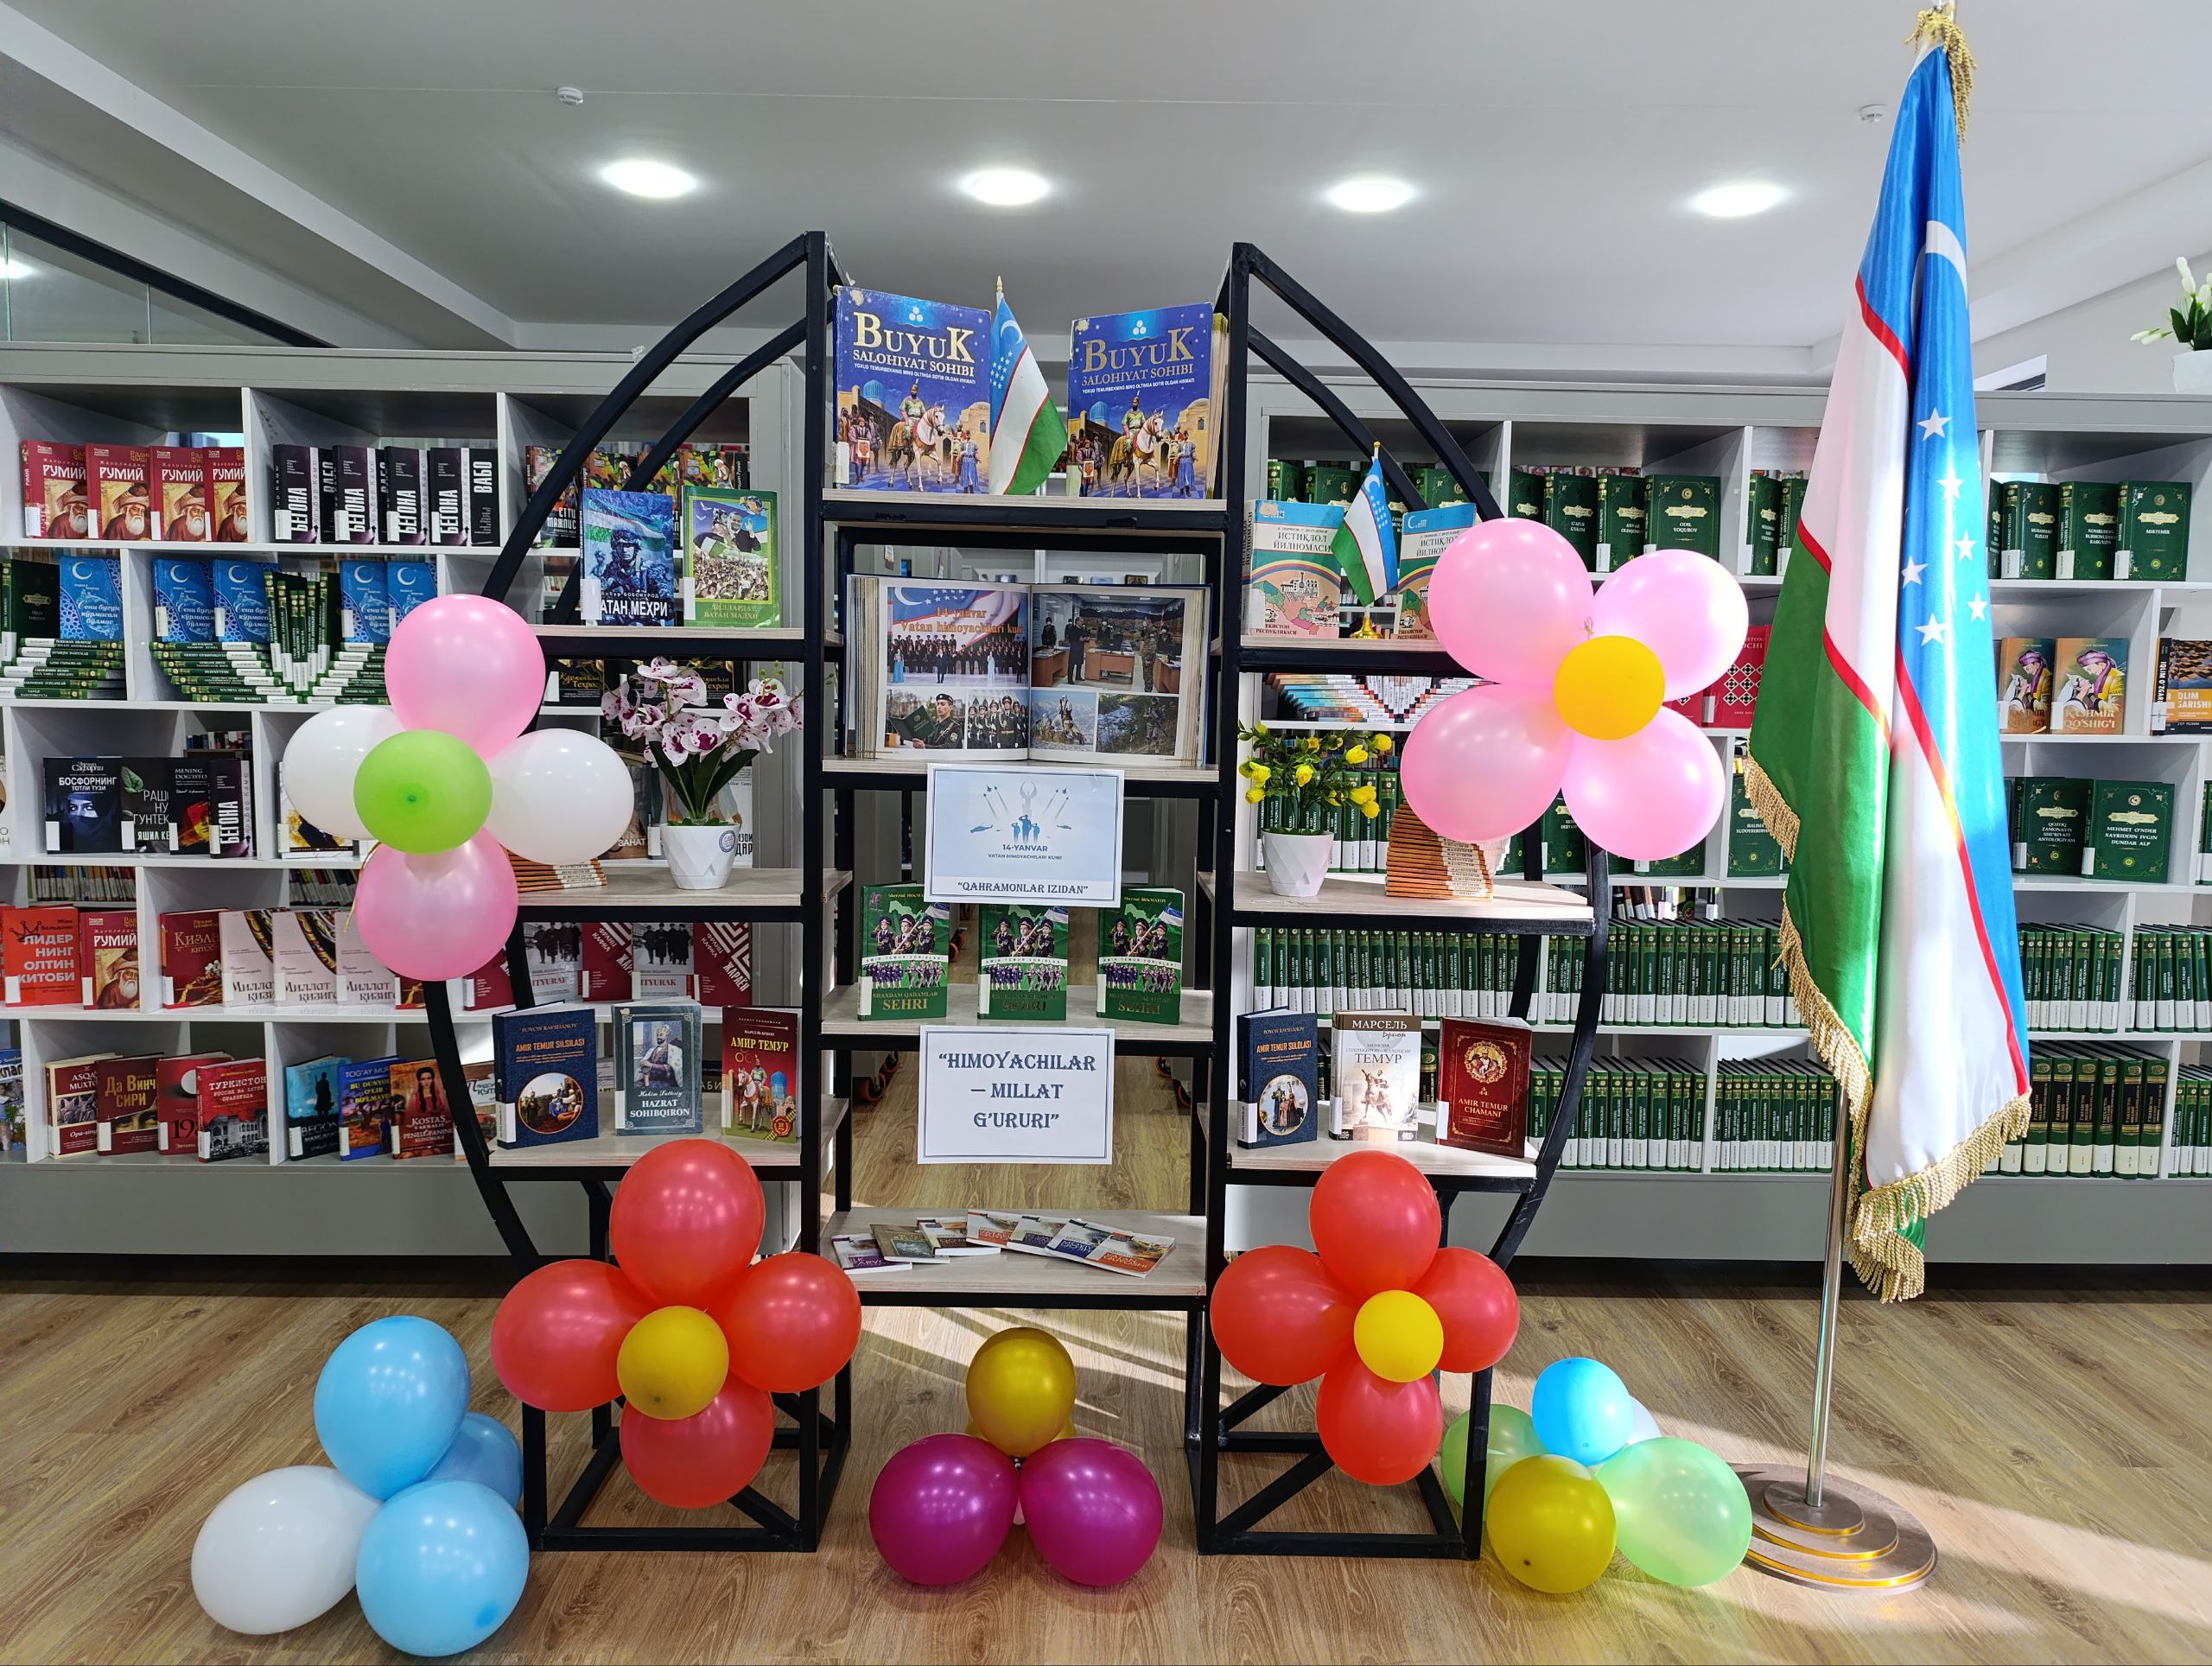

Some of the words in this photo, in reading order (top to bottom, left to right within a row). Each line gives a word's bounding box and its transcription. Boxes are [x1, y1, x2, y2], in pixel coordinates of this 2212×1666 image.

[853, 311, 975, 363] BUYUK
[1083, 327, 1194, 372] BUYUK
[853, 349, 927, 370] SALOHIYAT
[930, 360, 975, 377] SOHIBI
[1082, 369, 1148, 386] SALOHIYAT
[1151, 364, 1194, 378] SOHIBI
[43, 464, 86, 479] РУМИЙ
[99, 467, 143, 481] РУМИЙ
[162, 469, 204, 482] РУМИЙ
[213, 467, 245, 480] РУМИЙ
[473, 461, 493, 493] ВАБО
[439, 489, 459, 534] БЕГОНА
[546, 517, 577, 530] МАЖЛИС
[1278, 531, 1327, 543] ИСТИҚЛОЛ
[1421, 537, 1455, 549] ИСТИҚЛО
[1274, 541, 1331, 552] ЙИЛНОМАСИ
[1417, 548, 1446, 556] ЙИЛНОМ
[601, 601, 627, 615] АТАН
[630, 601, 668, 618] МЕҲРИ
[937, 607, 949, 617] 14
[900, 621, 933, 632] Vatan
[2065, 709, 2115, 718] KASHMIR
[2064, 720, 2116, 728] QO'SHIG'I
[59, 777, 117, 786] БОСФОРНИНГ
[143, 790, 169, 802] РАШ
[155, 802, 168, 813] НУ
[133, 814, 169, 825] ГУНТЕК
[218, 801, 239, 844] БЕГОНА
[138, 831, 159, 840] ЯШИЛ
[1002, 843, 1048, 852] 14-YANVAR
[958, 882, 1045, 893] “QAHRAMONLAR
[1047, 884, 1089, 894] IZIDAN”
[23, 934, 73, 945] ЛИДЕР
[93, 933, 137, 947] РУМИЙ
[175, 932, 219, 948] Қизла
[35, 947, 74, 957] НИНГ
[701, 937, 718, 958] КАФКА
[24, 959, 75, 970] ОЛТИН
[18, 972, 75, 983] КИТОБИ
[723, 961, 750, 992] ЖАРАЁН
[883, 998, 927, 1010] SEHRI
[1352, 1020, 1408, 1029] МАРСЕЛЬ
[516, 1044, 531, 1052] AMIR
[533, 1041, 555, 1051] TEMUR
[556, 1038, 585, 1048] SILSILASI
[730, 1037, 756, 1049] АМИР
[759, 1040, 789, 1052] ТЕМУР
[1256, 1045, 1270, 1053] AMIR
[1271, 1042, 1287, 1052] TEMUR
[1288, 1040, 1312, 1050] SULOLASI
[938, 1051, 1096, 1071] “HIMOYACHILAR
[1355, 1053, 1402, 1064] ТЕМУР
[73, 1071, 97, 1081] ASQA
[105, 1076, 123, 1097] Да
[127, 1074, 156, 1091] Винч
[209, 1076, 267, 1091] ТУРКИСТОН
[362, 1078, 390, 1088] DUNYO
[990, 1083, 1064, 1099] MILLAT
[117, 1092, 146, 1108] СИРИ
[642, 1099, 678, 1108] HAZRAT
[1459, 1098, 1478, 1107] AMIR
[1480, 1101, 1509, 1111] TEMUR
[630, 1108, 690, 1118] SOHIBQIRON
[1465, 1107, 1501, 1118] CHAMANI
[411, 1115, 446, 1126] KOSTAS
